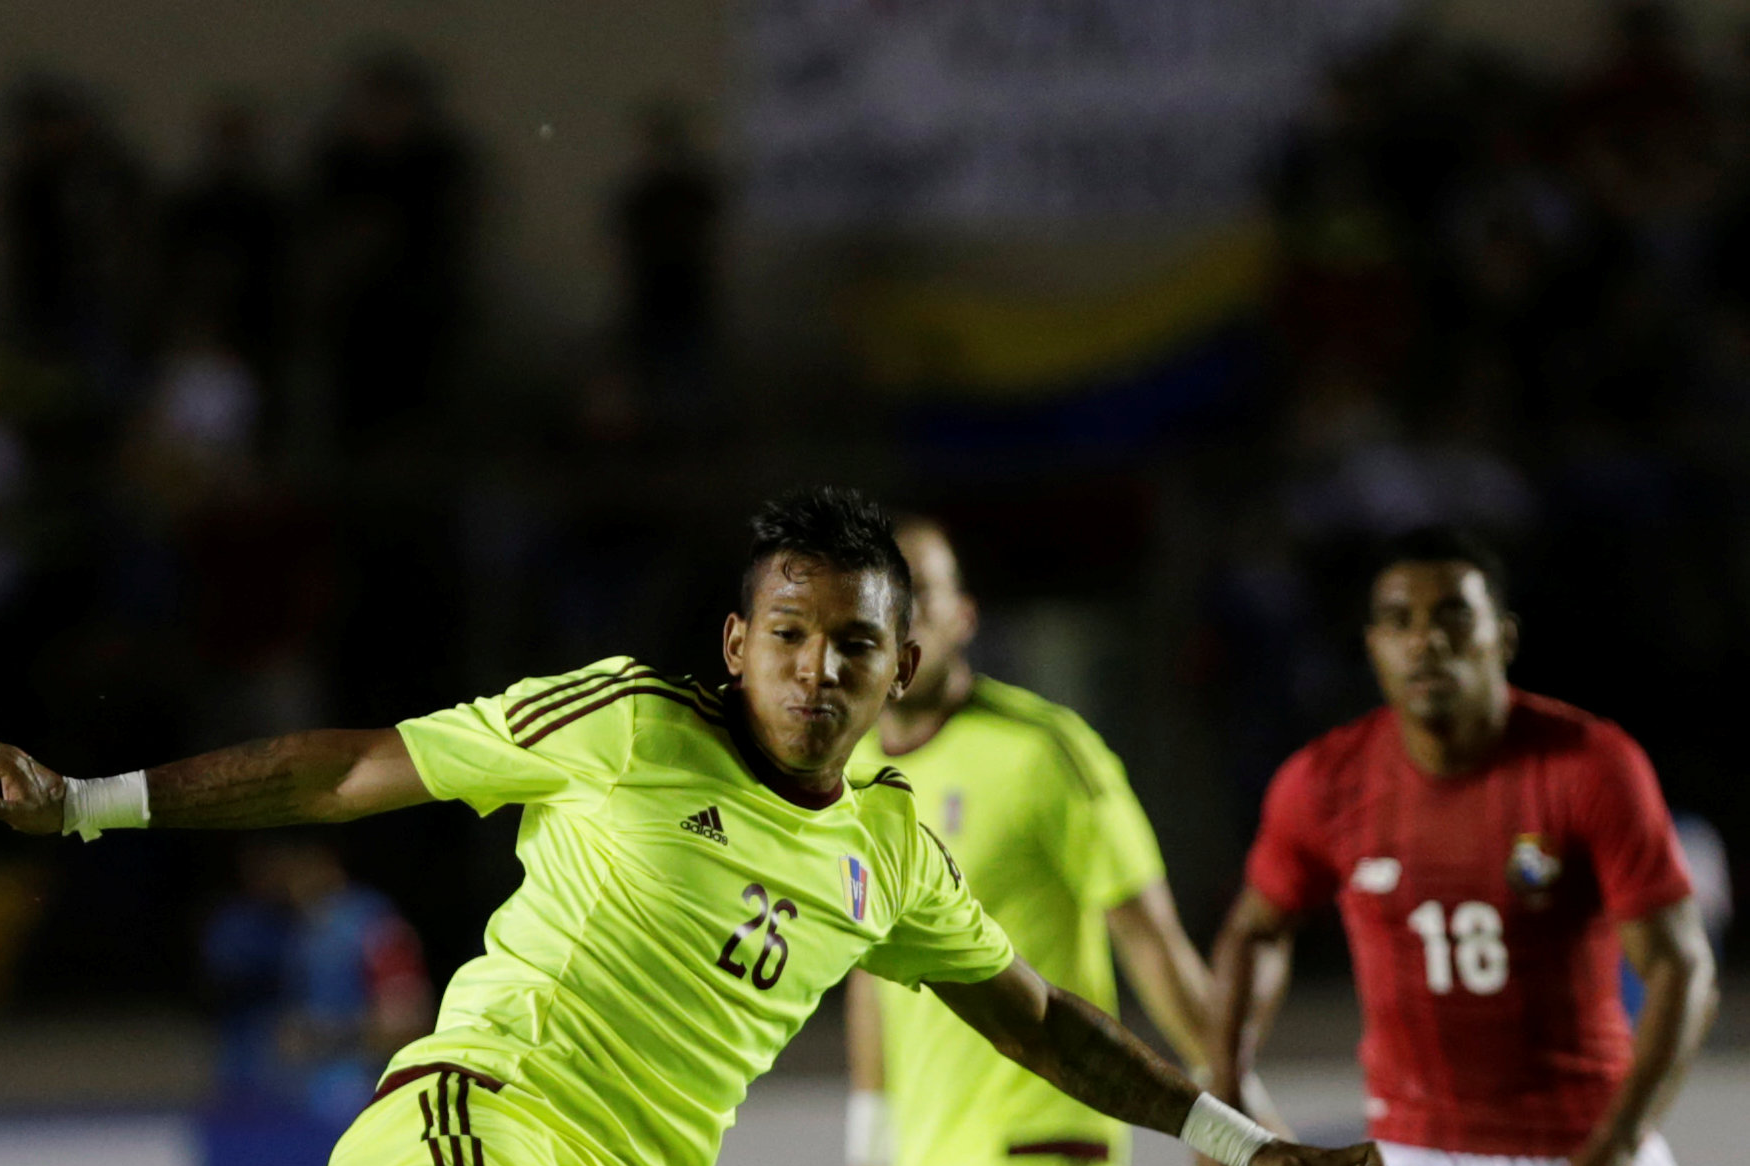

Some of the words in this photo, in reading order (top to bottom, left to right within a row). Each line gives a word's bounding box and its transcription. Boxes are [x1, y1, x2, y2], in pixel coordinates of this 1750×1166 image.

[680, 820, 728, 845] adidas
[716, 883, 797, 990] 26
[1406, 899, 1510, 997] 18
